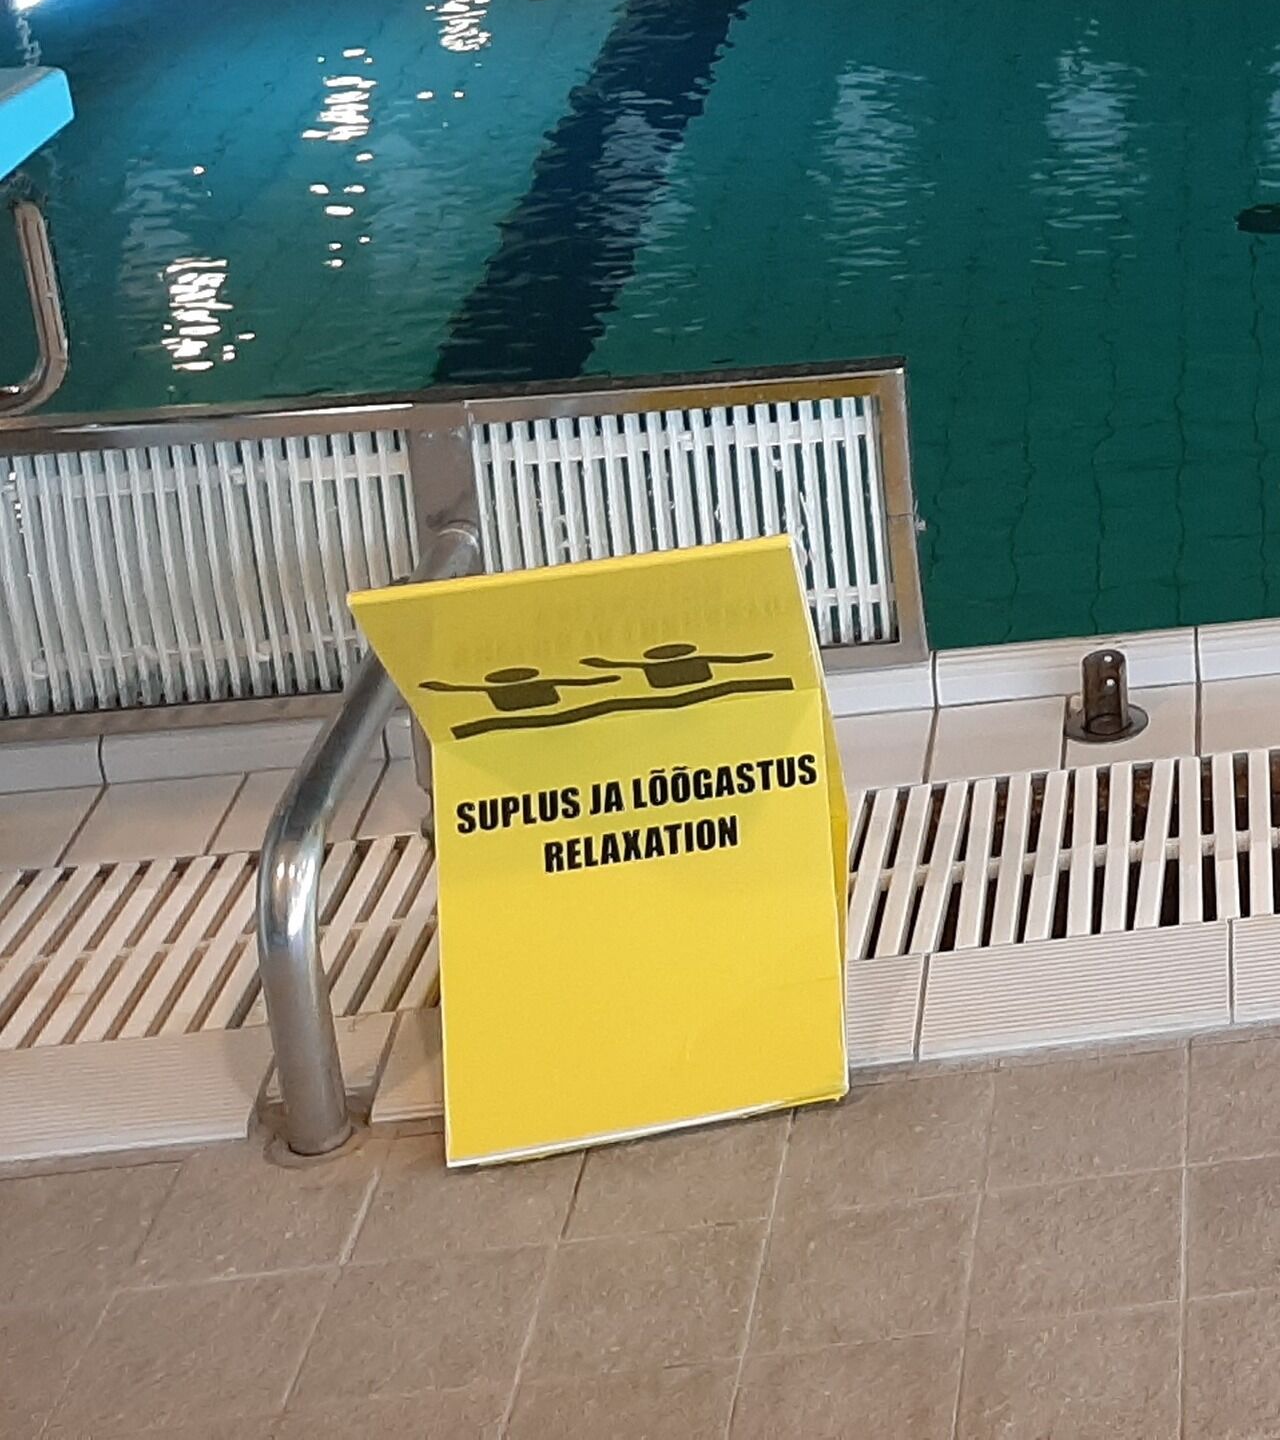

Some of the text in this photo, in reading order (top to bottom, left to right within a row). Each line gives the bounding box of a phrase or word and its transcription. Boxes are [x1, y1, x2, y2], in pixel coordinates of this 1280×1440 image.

[456, 753, 818, 834] SUPLUS JA LÕÕGASTUS
[544, 815, 739, 873] RELAXATION
